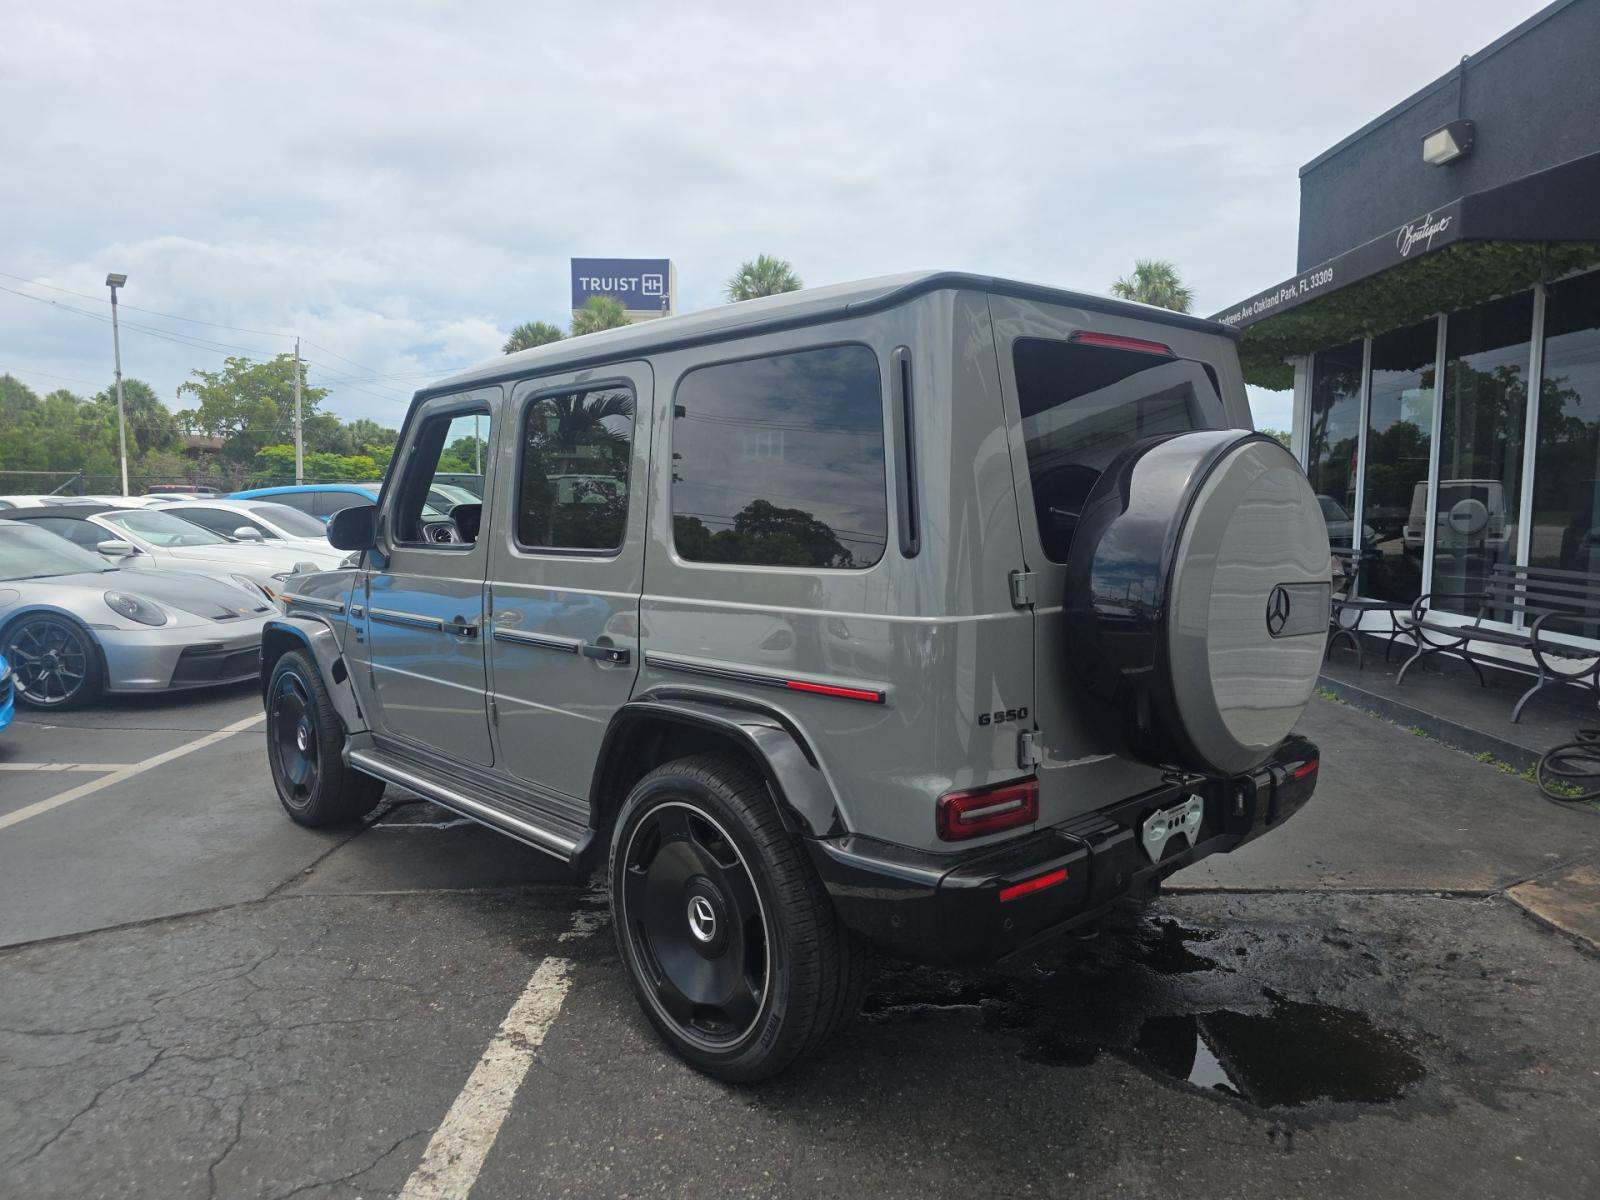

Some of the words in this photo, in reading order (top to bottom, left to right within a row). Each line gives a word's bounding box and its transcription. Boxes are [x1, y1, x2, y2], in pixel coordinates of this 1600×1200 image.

[1396, 213, 1452, 256] Boutique
[579, 277, 639, 291] TRUIST
[1242, 306, 1253, 319] Ave
[1253, 291, 1279, 314] Oakland
[1280, 284, 1298, 302] Park,
[1299, 278, 1309, 294] FL
[1310, 268, 1333, 288] 33309
